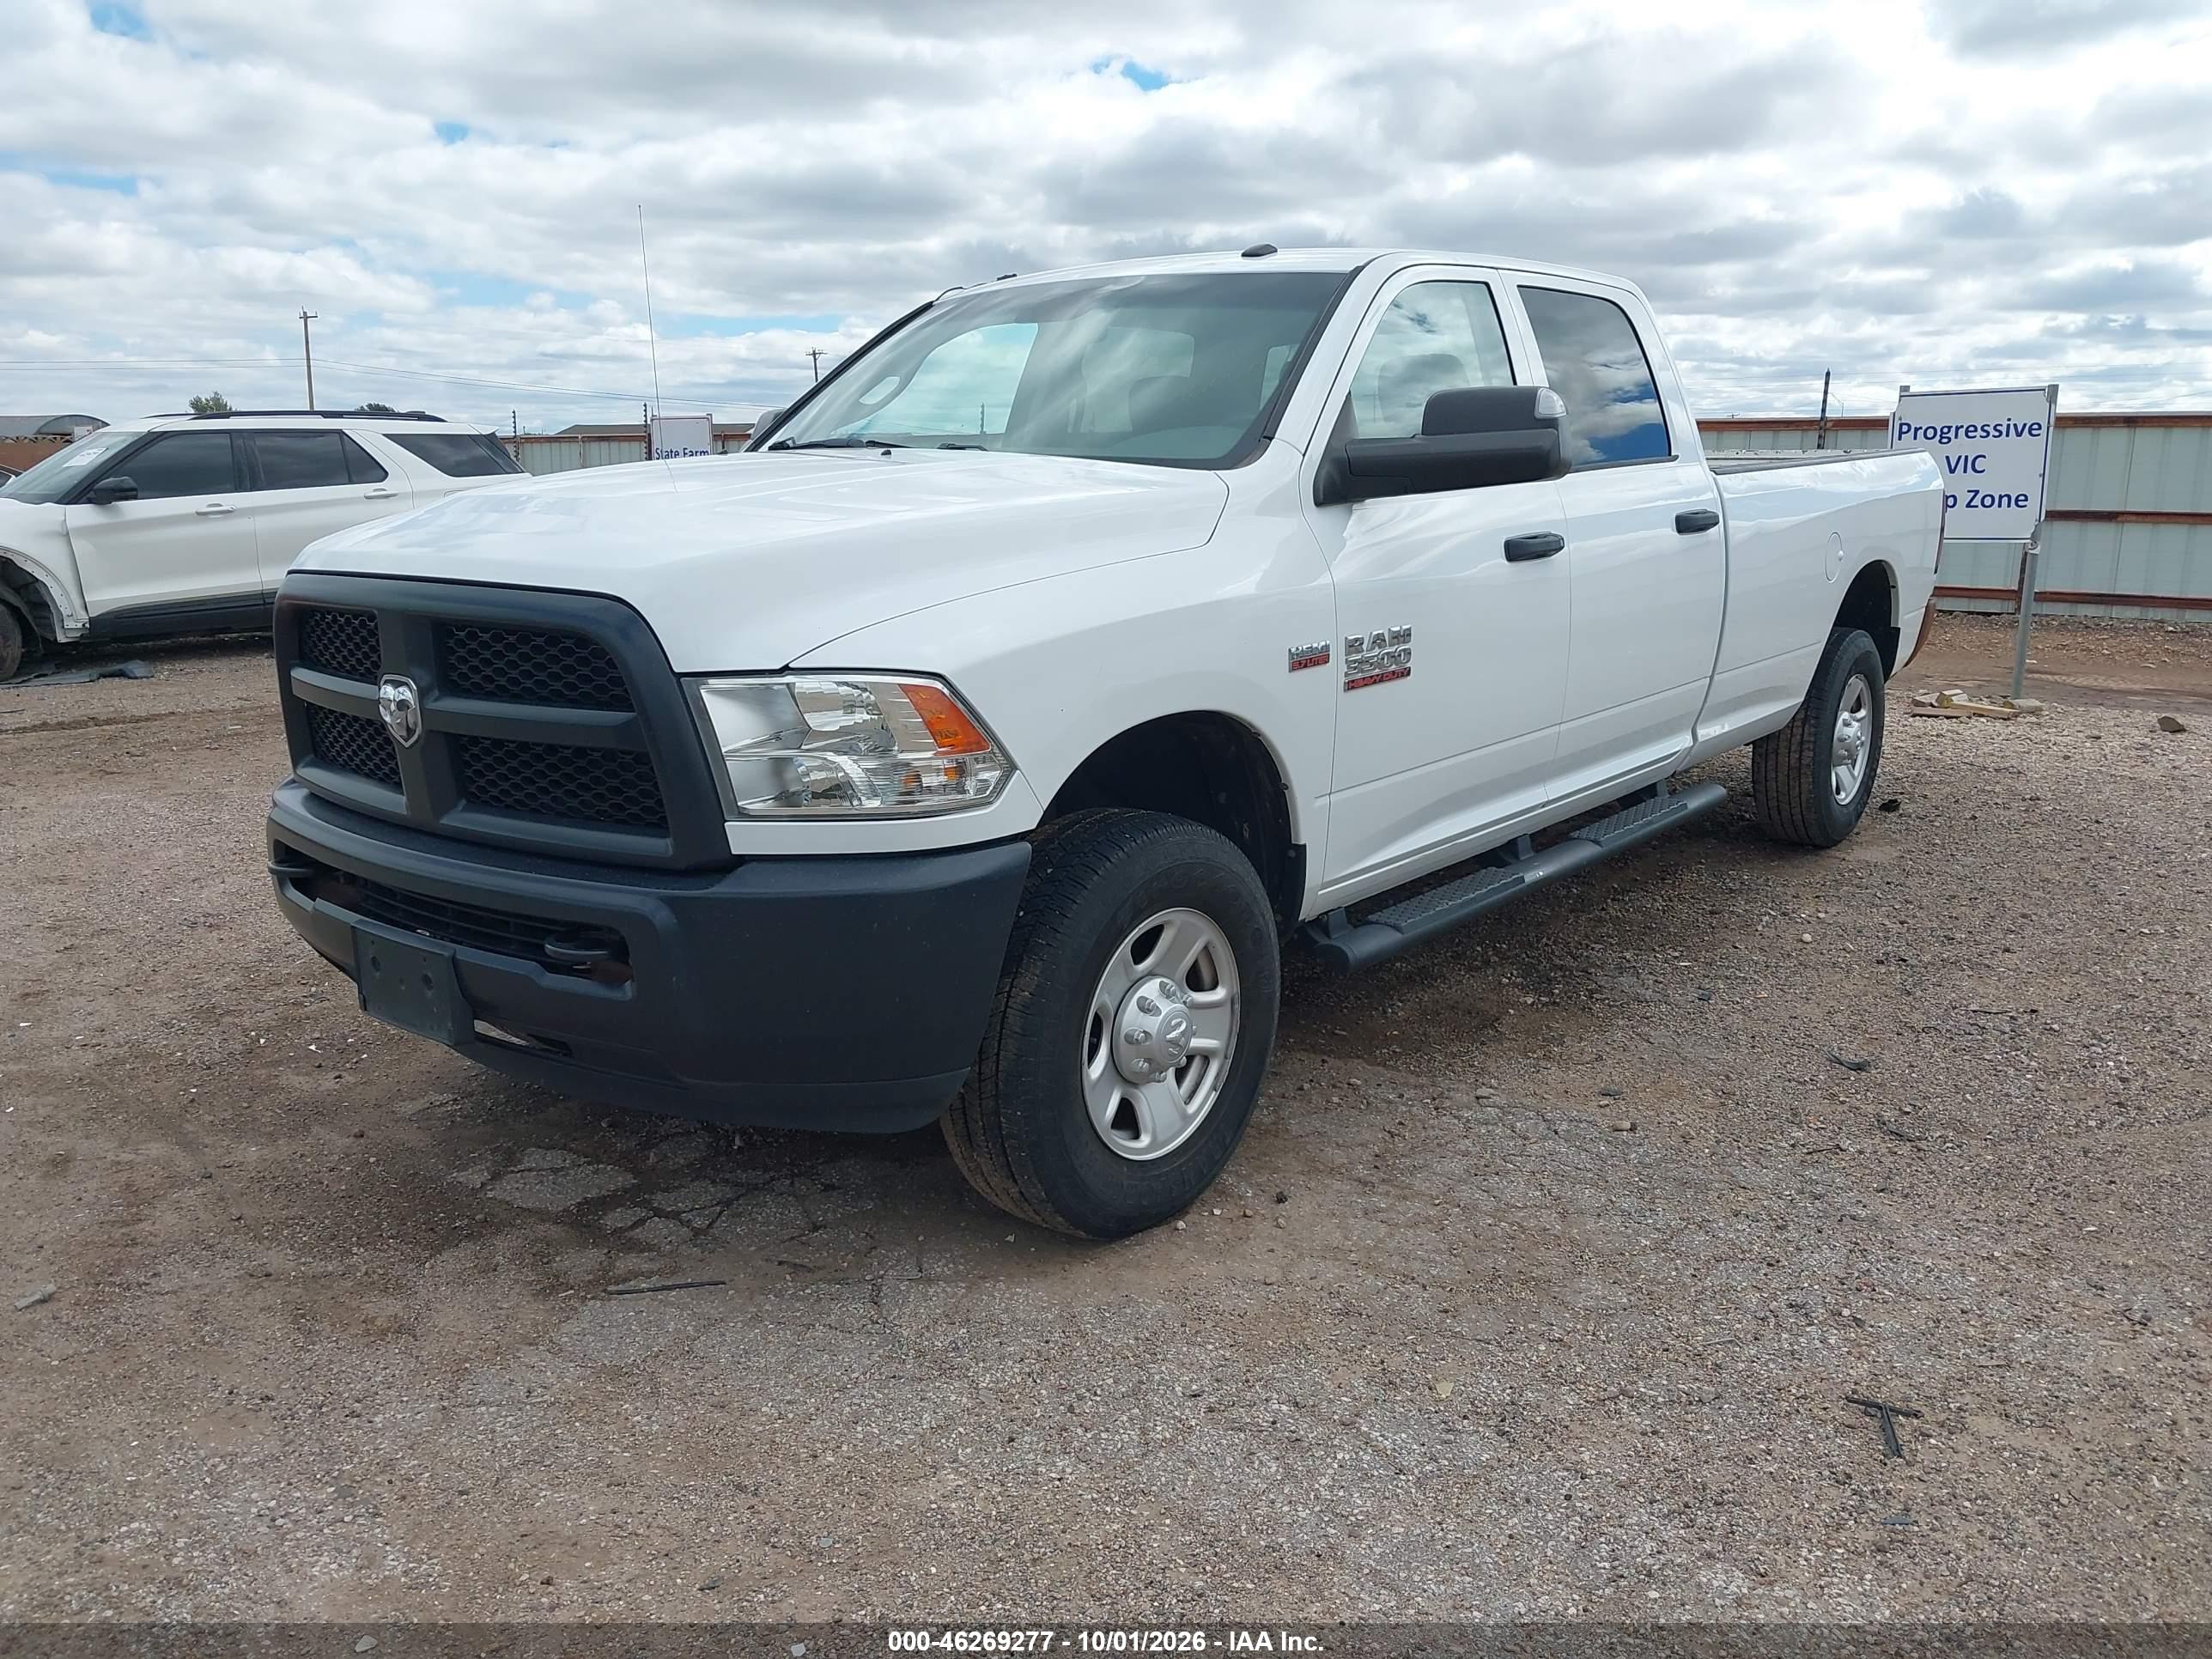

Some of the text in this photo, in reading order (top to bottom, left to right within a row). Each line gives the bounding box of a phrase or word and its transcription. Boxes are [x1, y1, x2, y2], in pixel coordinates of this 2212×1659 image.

[1898, 417, 2043, 445] Progressive
[655, 447, 710, 460] State Farm
[1945, 454, 1987, 474] VIC
[1965, 489, 2029, 509] Zone
[1288, 641, 1330, 660] HEMI
[1345, 625, 1412, 656] RAM
[1307, 655, 1329, 667] LITER
[1348, 666, 1411, 690] HEAVY DUTY
